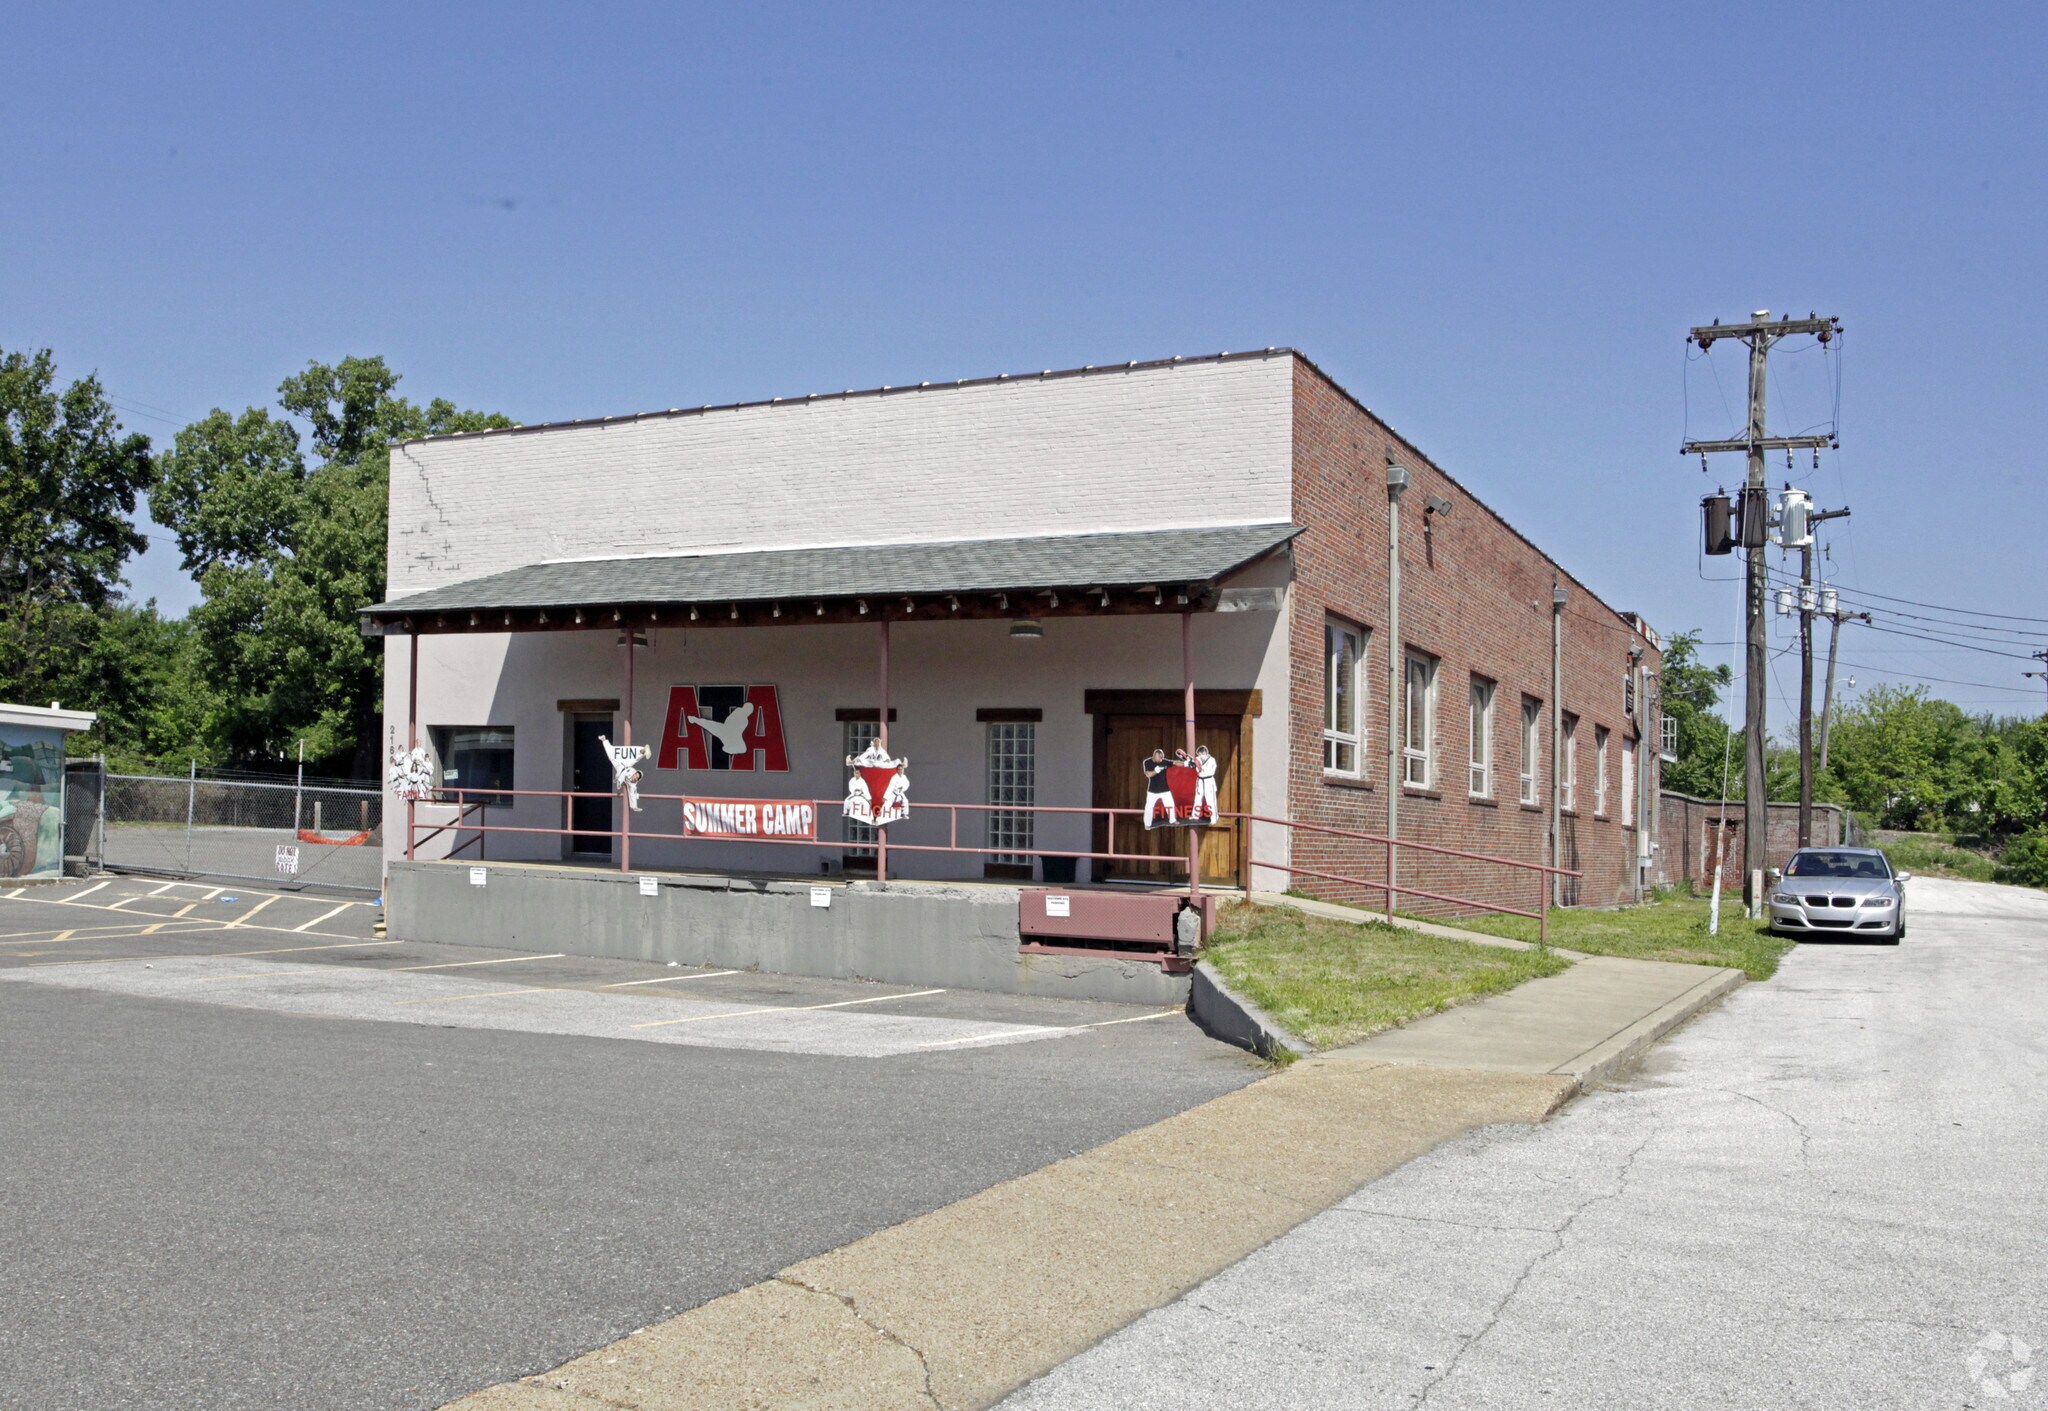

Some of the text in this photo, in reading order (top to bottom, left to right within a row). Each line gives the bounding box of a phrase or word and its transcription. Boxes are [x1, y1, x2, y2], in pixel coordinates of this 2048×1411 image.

[656, 685, 789, 772] ATA
[614, 747, 637, 760] FUN
[396, 790, 428, 800] FAMILY
[683, 801, 813, 836] SUMMER CAMP
[852, 802, 900, 819] FLIGHT
[1153, 804, 1213, 820] FITNESS
